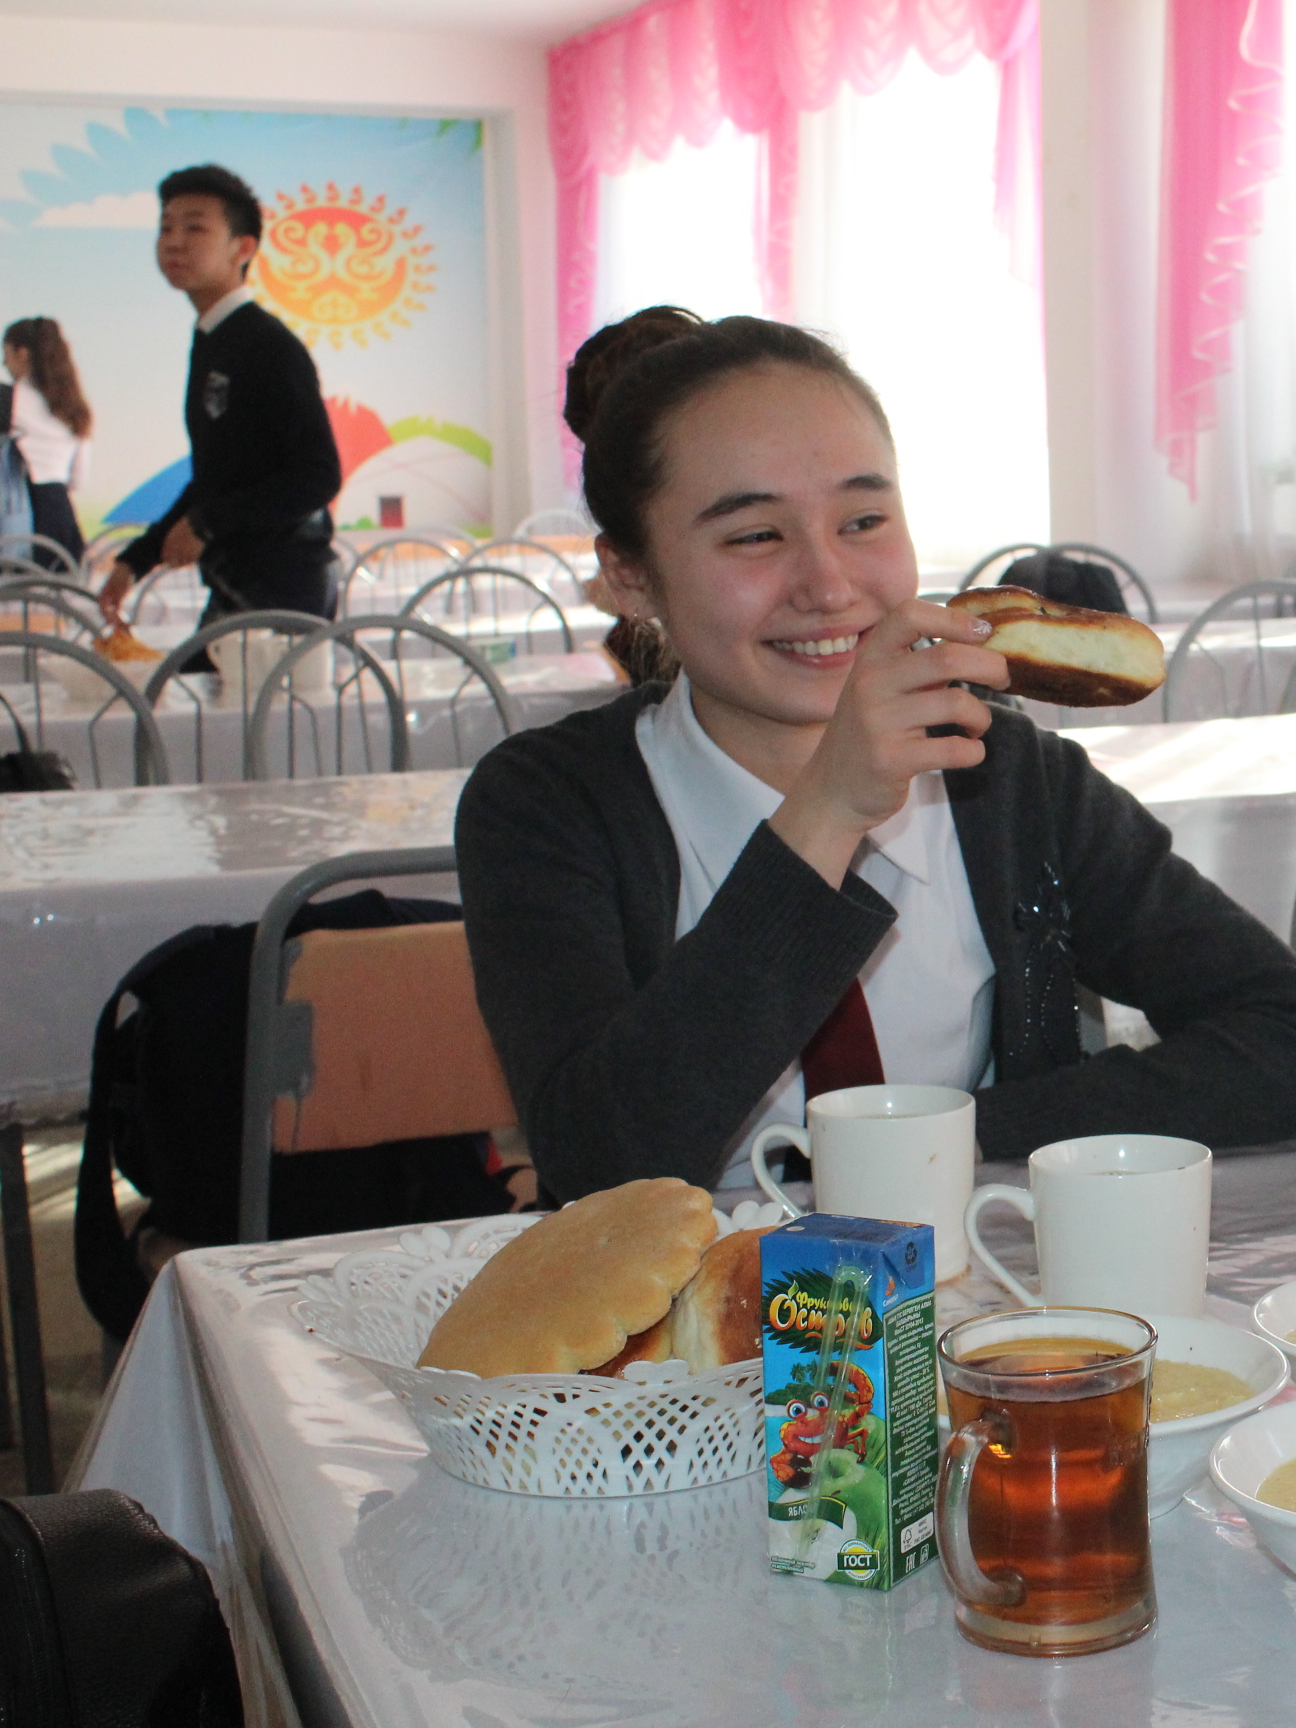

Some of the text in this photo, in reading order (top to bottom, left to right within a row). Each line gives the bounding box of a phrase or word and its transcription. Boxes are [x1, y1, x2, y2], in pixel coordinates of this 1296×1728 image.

[796, 1291, 856, 1312] Фрукв
[769, 1294, 872, 1339] Острв
[788, 1504, 808, 1517] ЯБЛО
[843, 1554, 872, 1567] ГОСТ
